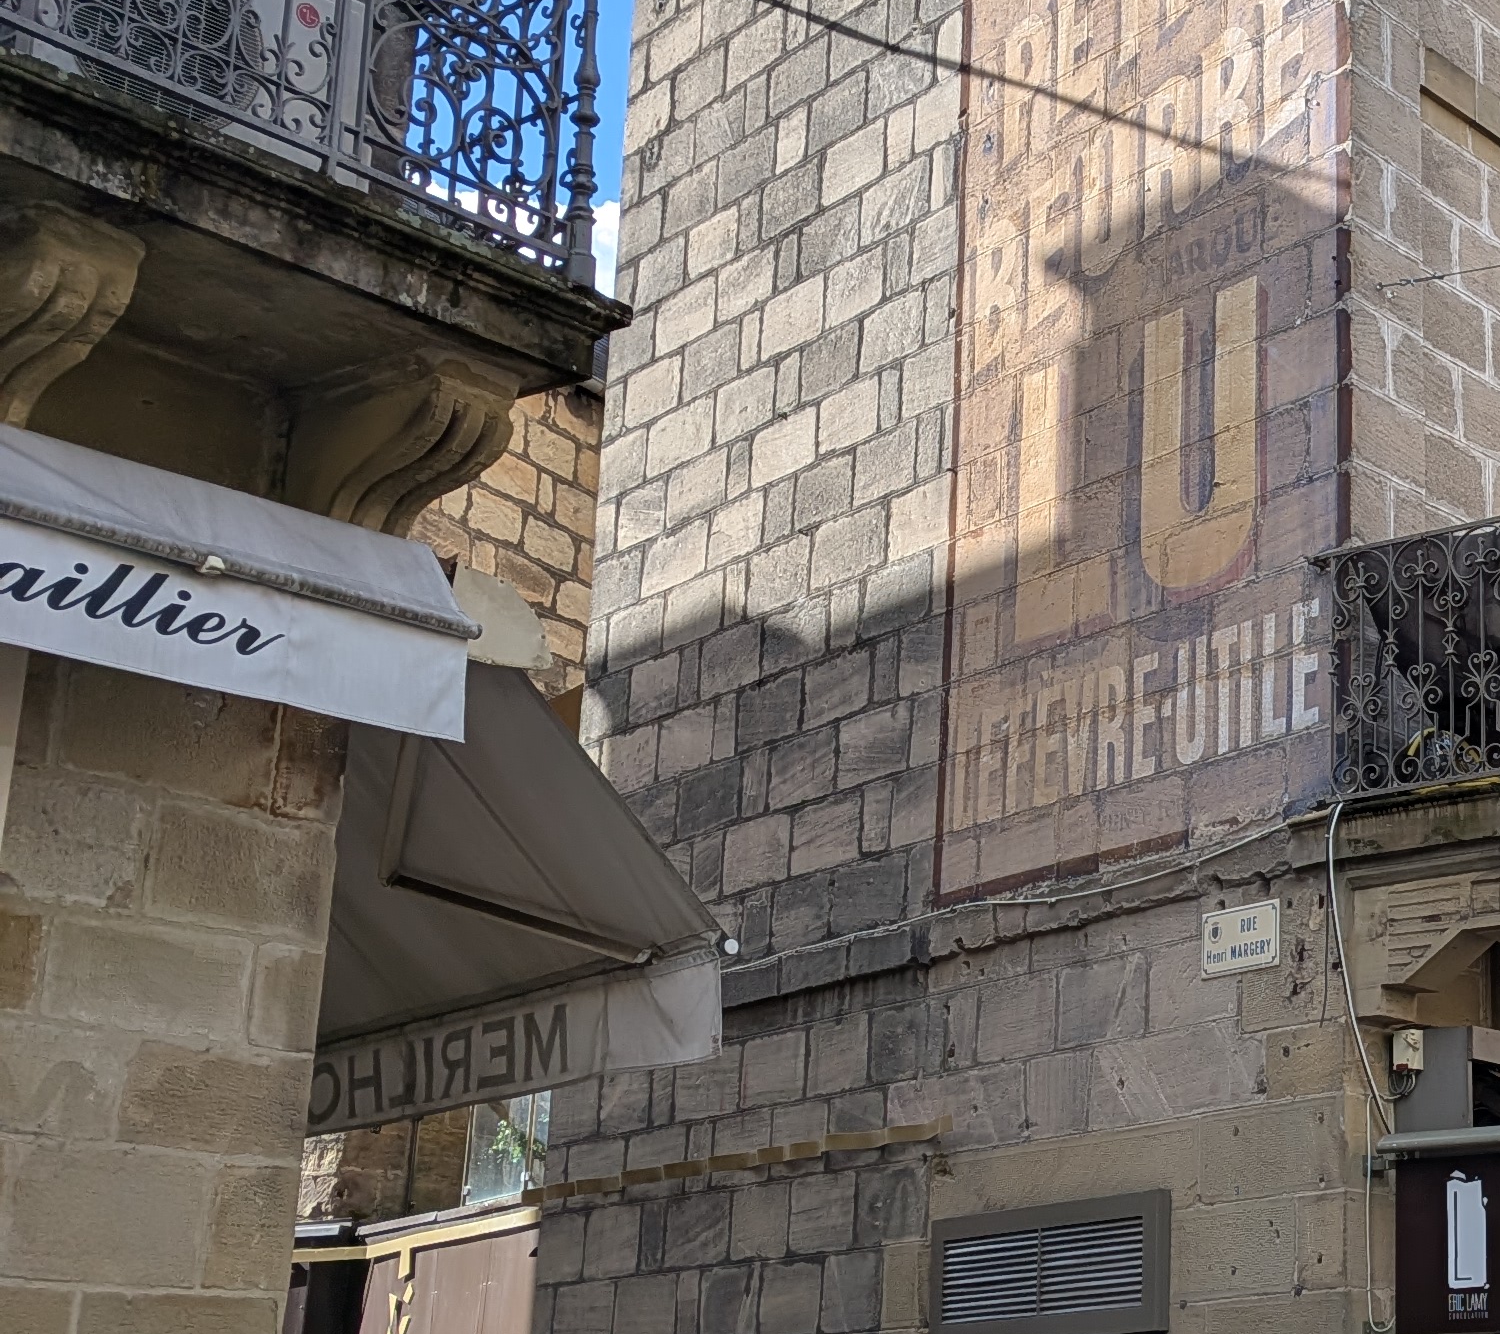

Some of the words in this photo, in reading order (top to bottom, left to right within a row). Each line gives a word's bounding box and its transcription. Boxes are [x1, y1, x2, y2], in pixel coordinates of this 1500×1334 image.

[1012, 274, 1262, 644] LU
[0, 561, 285, 656] aillier
[1240, 916, 1258, 934] RUE
[1206, 949, 1227, 965] Henri
[1230, 938, 1272, 960] MARGERY
[1448, 1293, 1465, 1312] ERIC
[1466, 1292, 1489, 1312] LAMY
